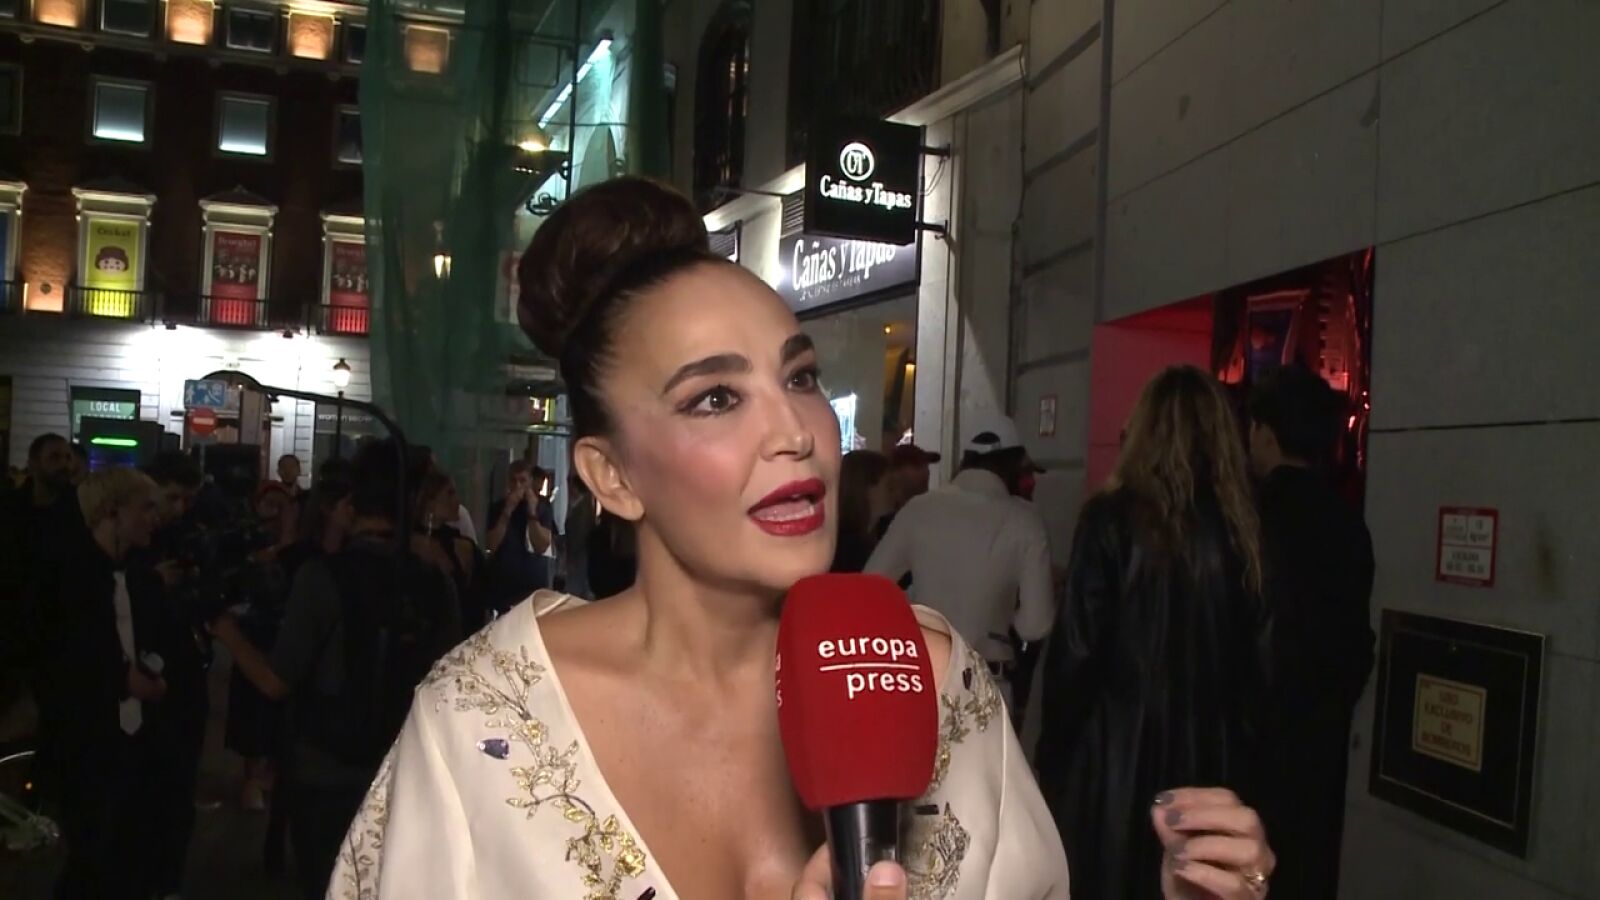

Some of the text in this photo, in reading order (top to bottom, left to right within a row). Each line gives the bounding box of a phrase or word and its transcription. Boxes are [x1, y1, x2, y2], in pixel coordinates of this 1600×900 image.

[820, 175, 863, 203] Cañas
[792, 239, 836, 291] Cañas
[89, 401, 120, 412] LOCAL
[818, 637, 918, 661] europa
[847, 672, 923, 699] press
